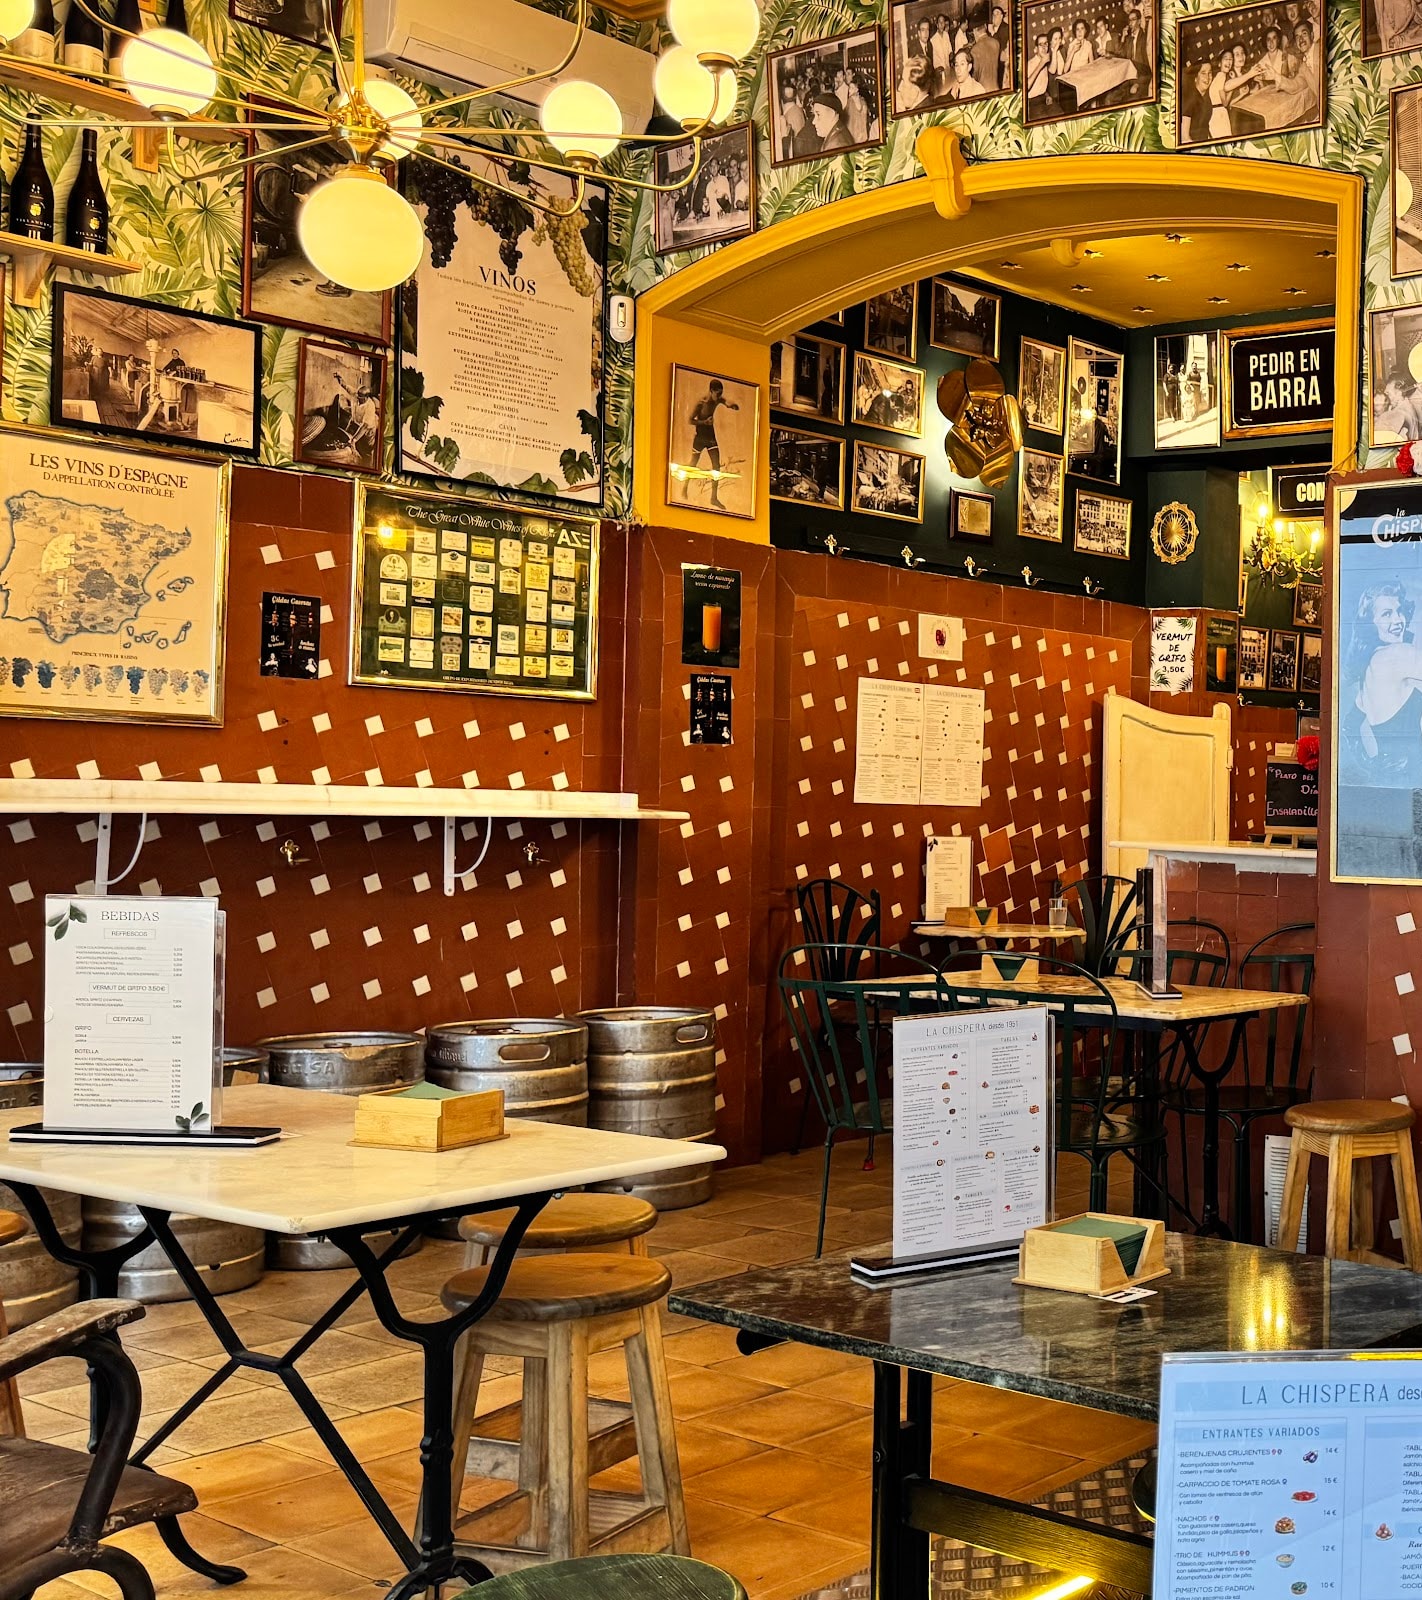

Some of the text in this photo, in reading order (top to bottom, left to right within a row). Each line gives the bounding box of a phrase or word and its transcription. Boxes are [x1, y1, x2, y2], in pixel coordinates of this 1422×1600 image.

[478, 265, 537, 296] VINOS
[1250, 348, 1320, 378] PEDIR EN
[1250, 375, 1322, 411] BARRA
[29, 453, 189, 489] LES VINS D'ESPAGNE
[406, 505, 428, 519] The
[428, 510, 458, 525] Great
[459, 513, 490, 528] White
[491, 518, 522, 533] Wines
[521, 523, 530, 538] of
[1156, 633, 1193, 641] VERMUT
[1169, 644, 1180, 652] DE
[101, 910, 160, 922] BEBIDAS
[926, 1020, 1019, 1037] LA CHISPERA desde 1951
[1242, 1385, 1268, 1404] LA
[1281, 1383, 1389, 1404] CHISPERA
[1202, 1426, 1320, 1439] ENTRANTES VARIADOS
[1227, 1449, 1271, 1457] CRUJIENTES
